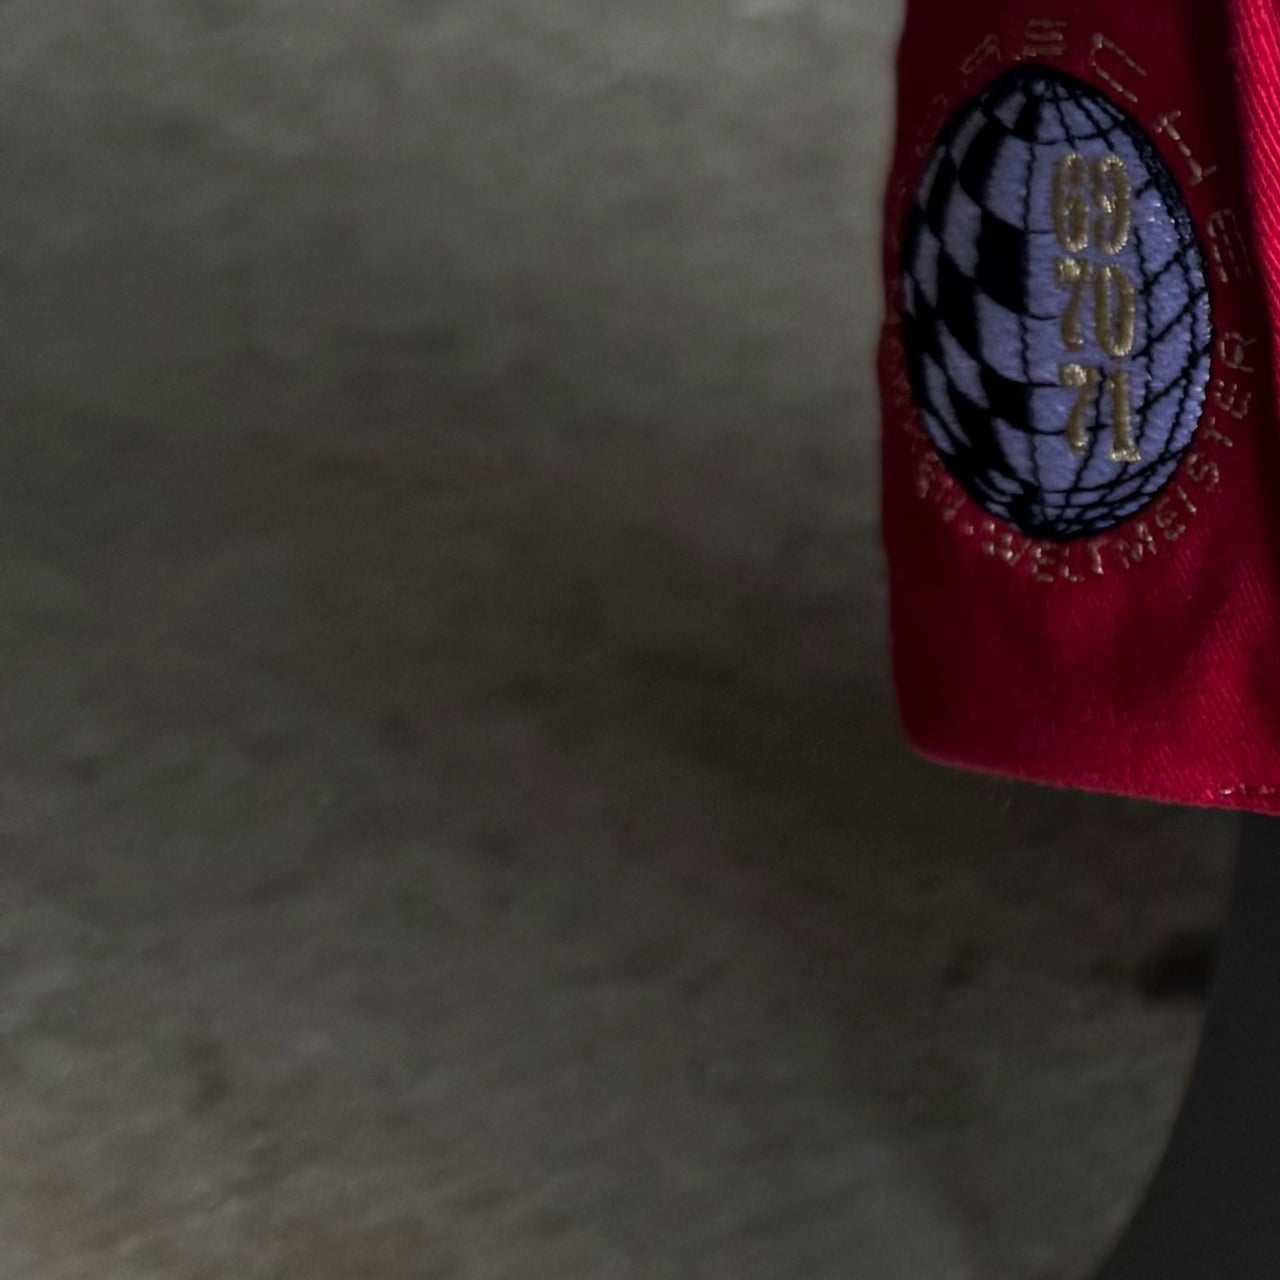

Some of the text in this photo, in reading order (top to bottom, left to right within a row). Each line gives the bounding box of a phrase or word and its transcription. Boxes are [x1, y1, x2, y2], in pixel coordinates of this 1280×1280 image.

[1051, 152, 1132, 257] 69
[1053, 256, 1136, 358] 70
[1057, 362, 1143, 463] 71
